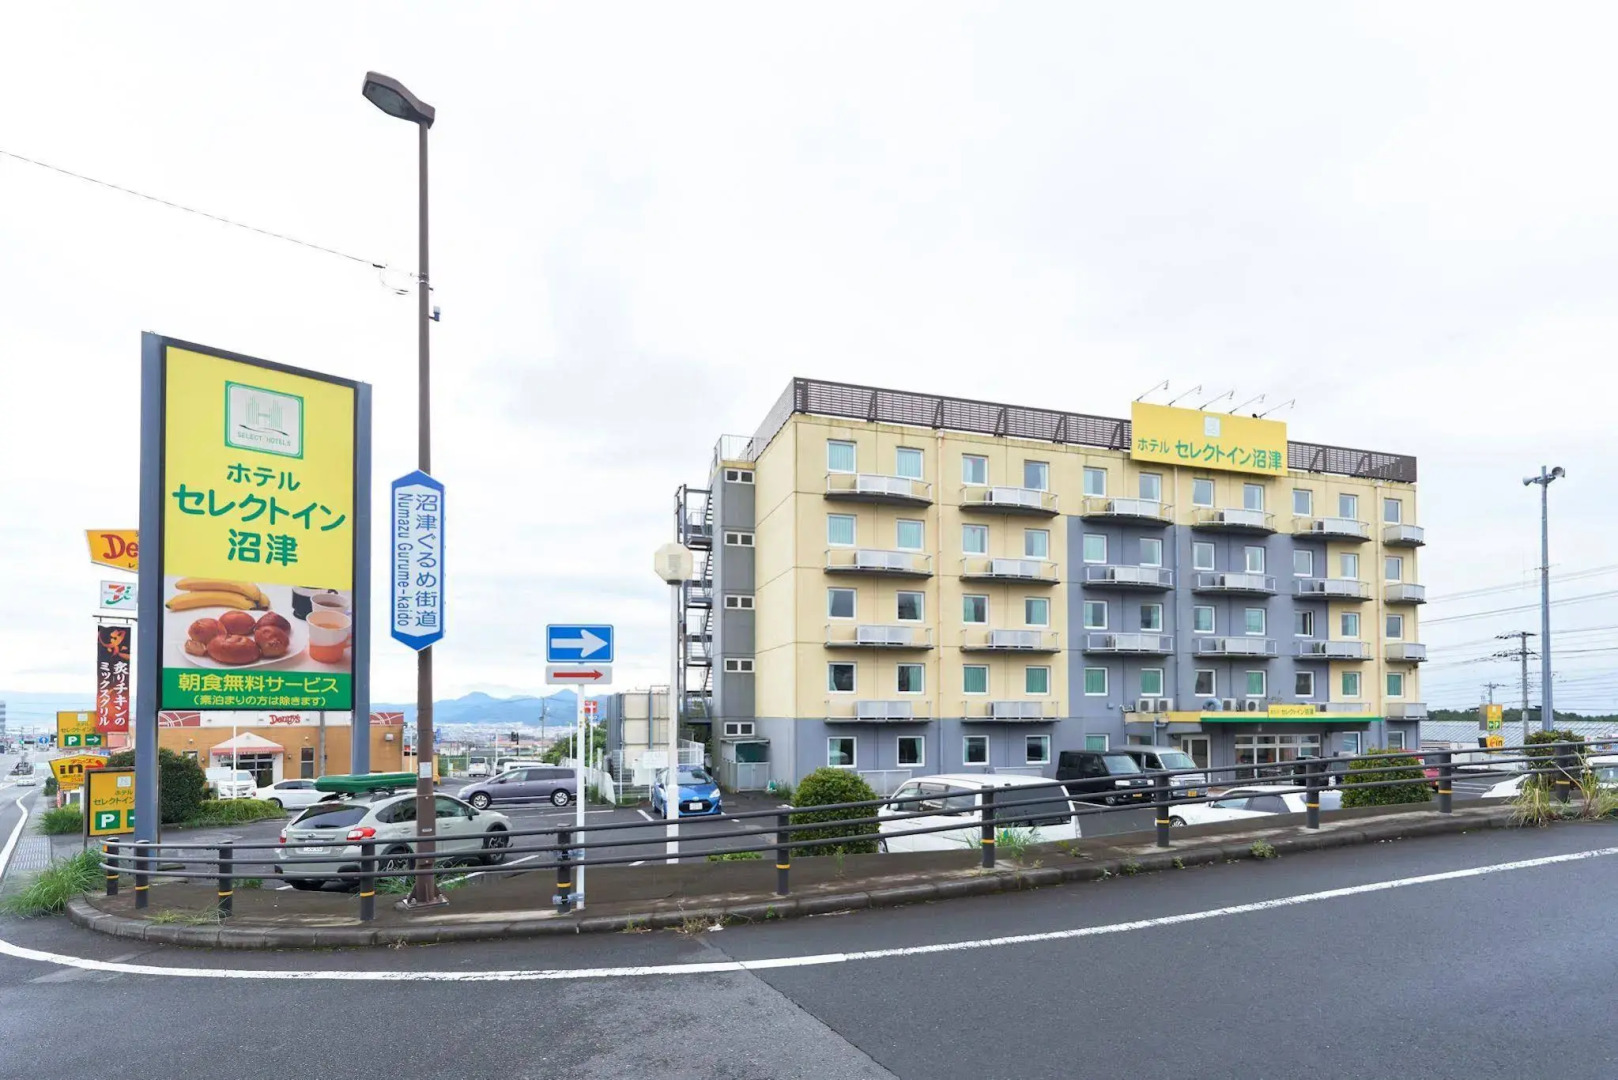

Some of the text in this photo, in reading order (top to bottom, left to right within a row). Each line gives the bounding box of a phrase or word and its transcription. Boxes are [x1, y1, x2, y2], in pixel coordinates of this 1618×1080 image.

[237, 431, 291, 447] SELECT HOTELS
[1137, 437, 1283, 471] ホテル セレクトイン沼津
[227, 463, 300, 491] ホテル
[172, 484, 346, 532] セレクトイン
[228, 529, 298, 566] 沼津
[397, 493, 414, 627] Numazu Gurume-kaido
[415, 493, 438, 628] 沼津ぐるめ街道
[113, 661, 130, 726] 炙りチキンの
[178, 673, 339, 693] 朝食無料サービス
[269, 714, 301, 725] Denny's
[68, 736, 78, 745] P
[101, 814, 115, 828] P
